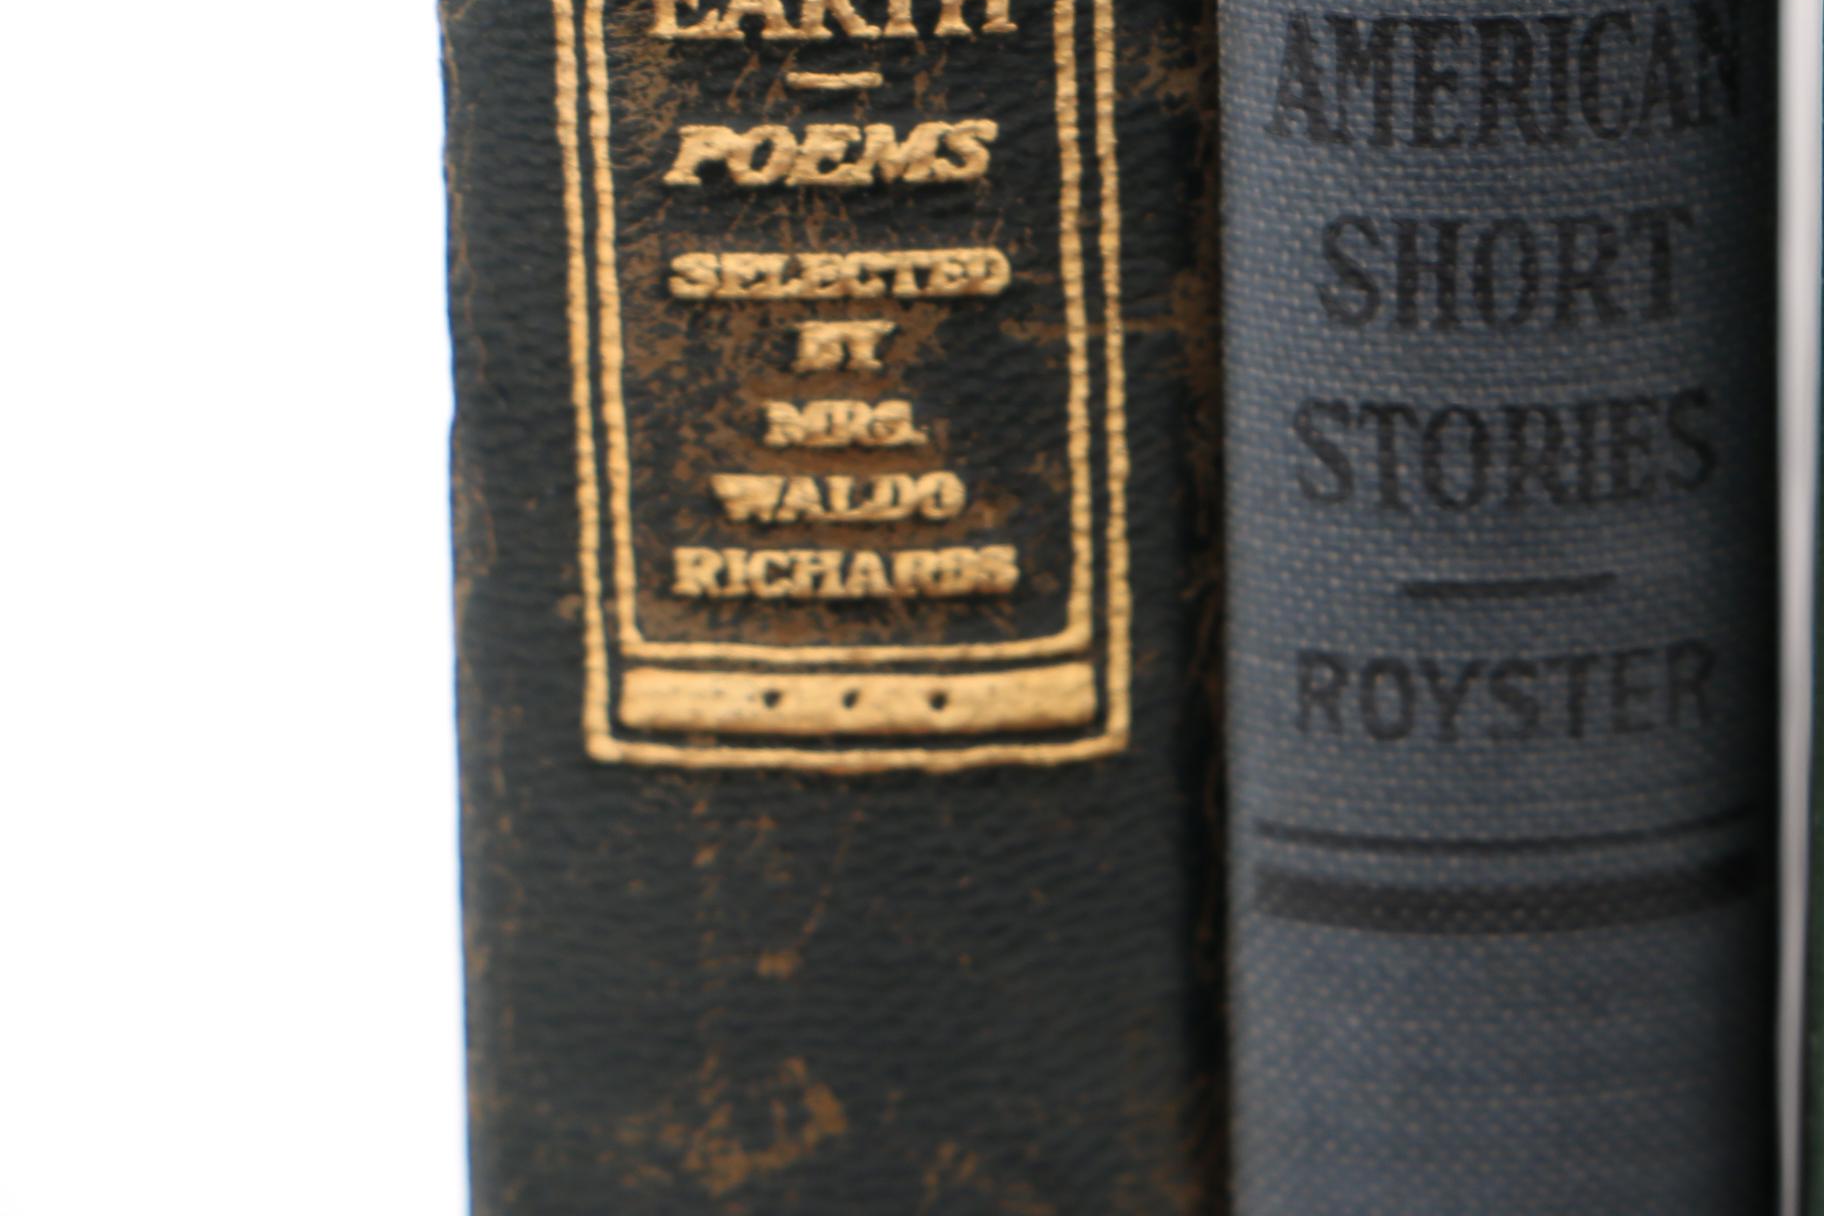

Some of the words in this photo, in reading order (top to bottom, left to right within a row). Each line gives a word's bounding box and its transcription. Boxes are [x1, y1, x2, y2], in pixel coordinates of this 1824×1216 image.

[663, 118, 999, 186] POEMS
[669, 246, 1012, 300] SELECTED
[1318, 203, 1696, 332] SHORT
[793, 318, 897, 371] BY
[1292, 389, 1718, 515] STORIES
[710, 471, 967, 522] WALDO
[672, 545, 1021, 598] RICHARDS
[1295, 639, 1716, 743] ROYSTER
